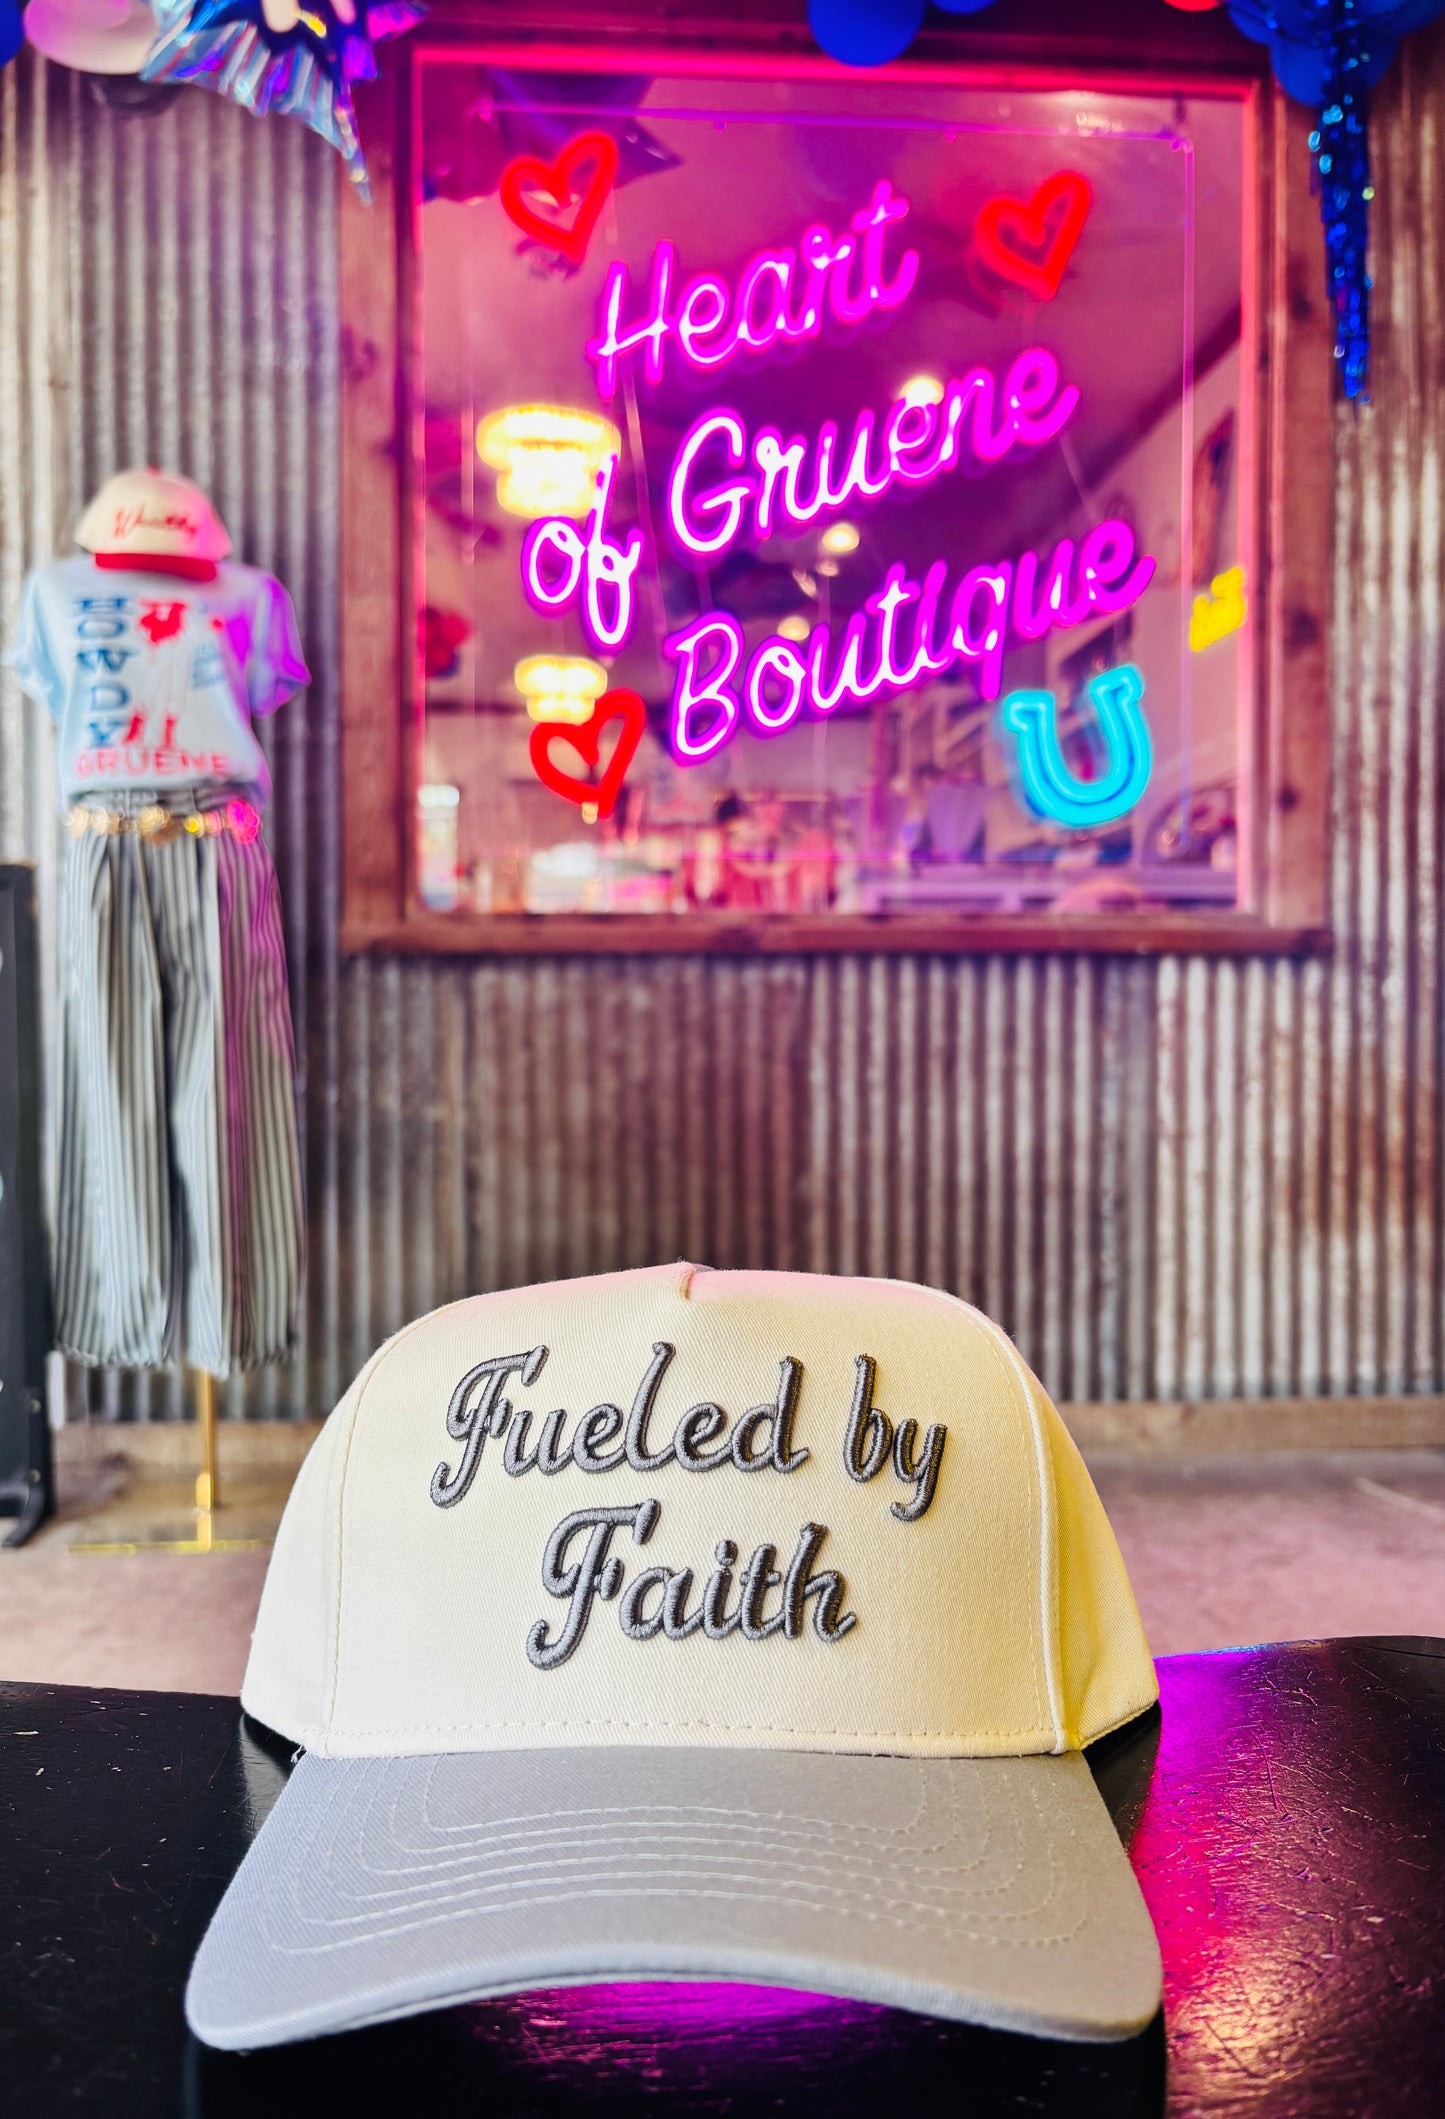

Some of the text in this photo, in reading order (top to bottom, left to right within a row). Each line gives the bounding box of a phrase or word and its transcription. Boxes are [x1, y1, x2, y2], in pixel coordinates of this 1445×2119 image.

[587, 180, 919, 398] Heart
[521, 347, 1082, 652] of Gruene
[664, 519, 1157, 767] Boutique
[430, 1341, 948, 1521] Fueled by
[525, 1498, 858, 1670] Faith
